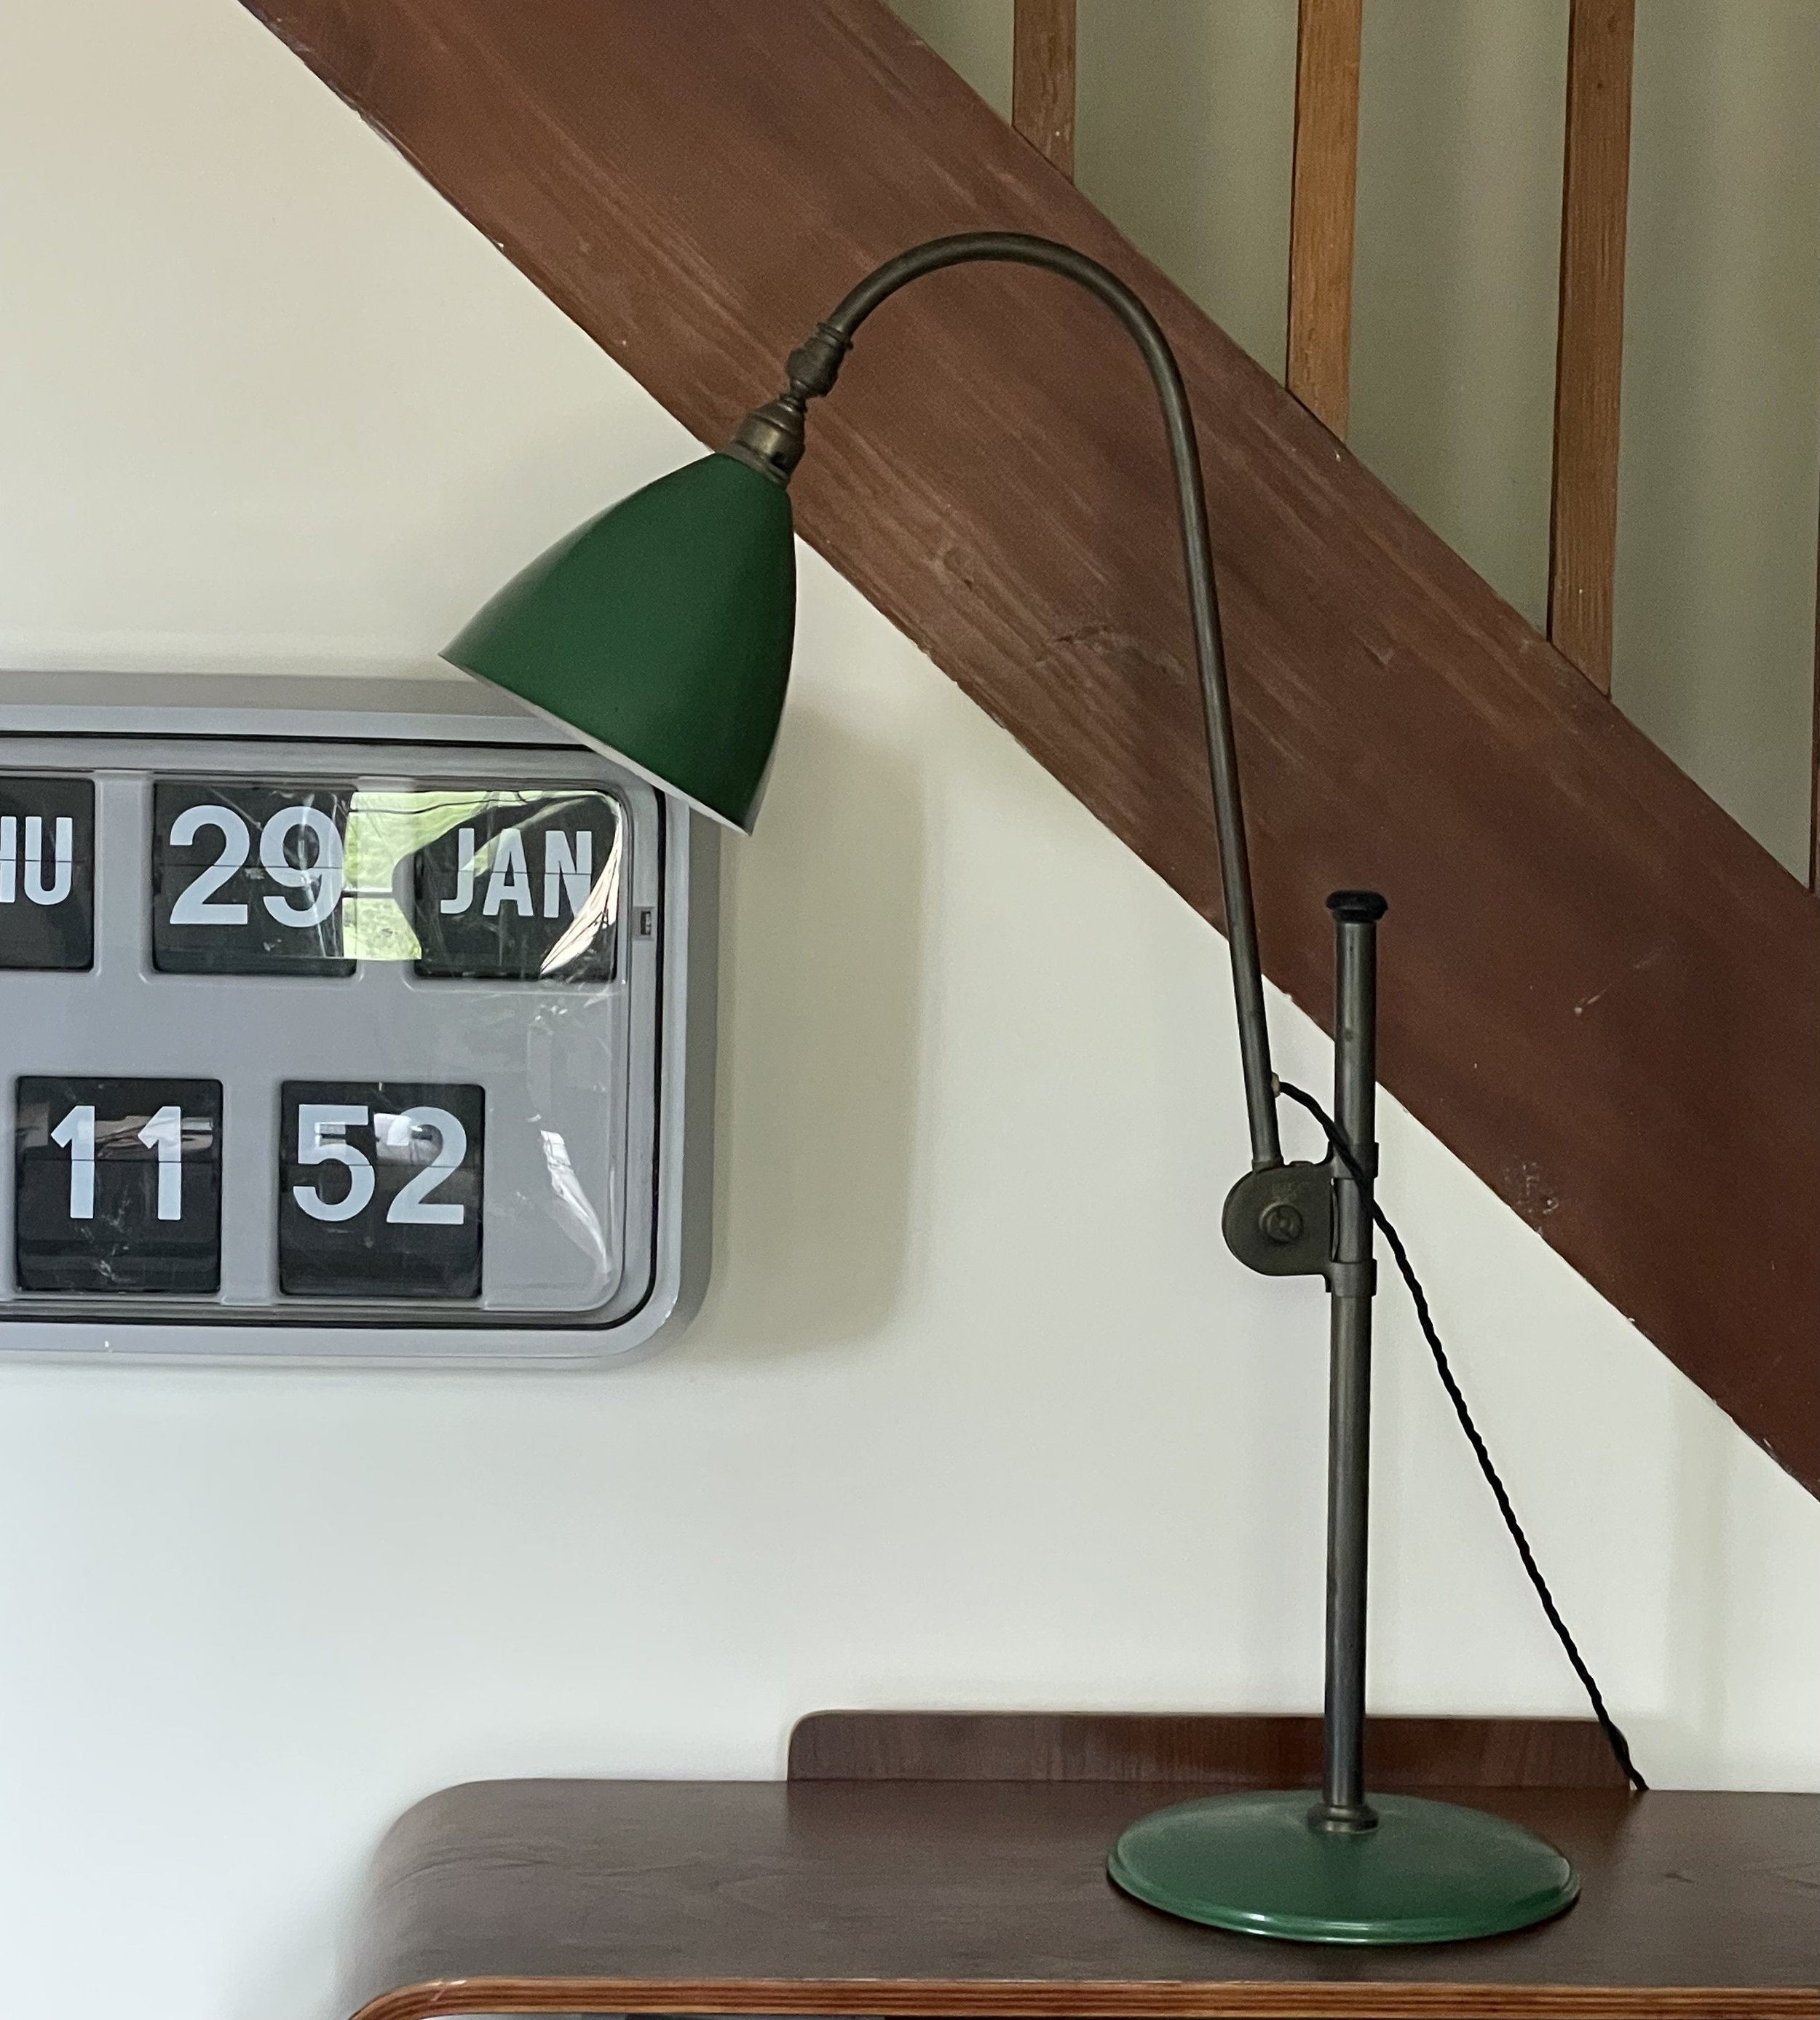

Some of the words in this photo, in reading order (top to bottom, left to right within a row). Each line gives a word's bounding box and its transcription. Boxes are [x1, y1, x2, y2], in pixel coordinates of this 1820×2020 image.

[170, 804, 343, 927] 29
[440, 828, 592, 918] JAN
[51, 1105, 181, 1220] 11
[293, 1104, 467, 1224] 52
